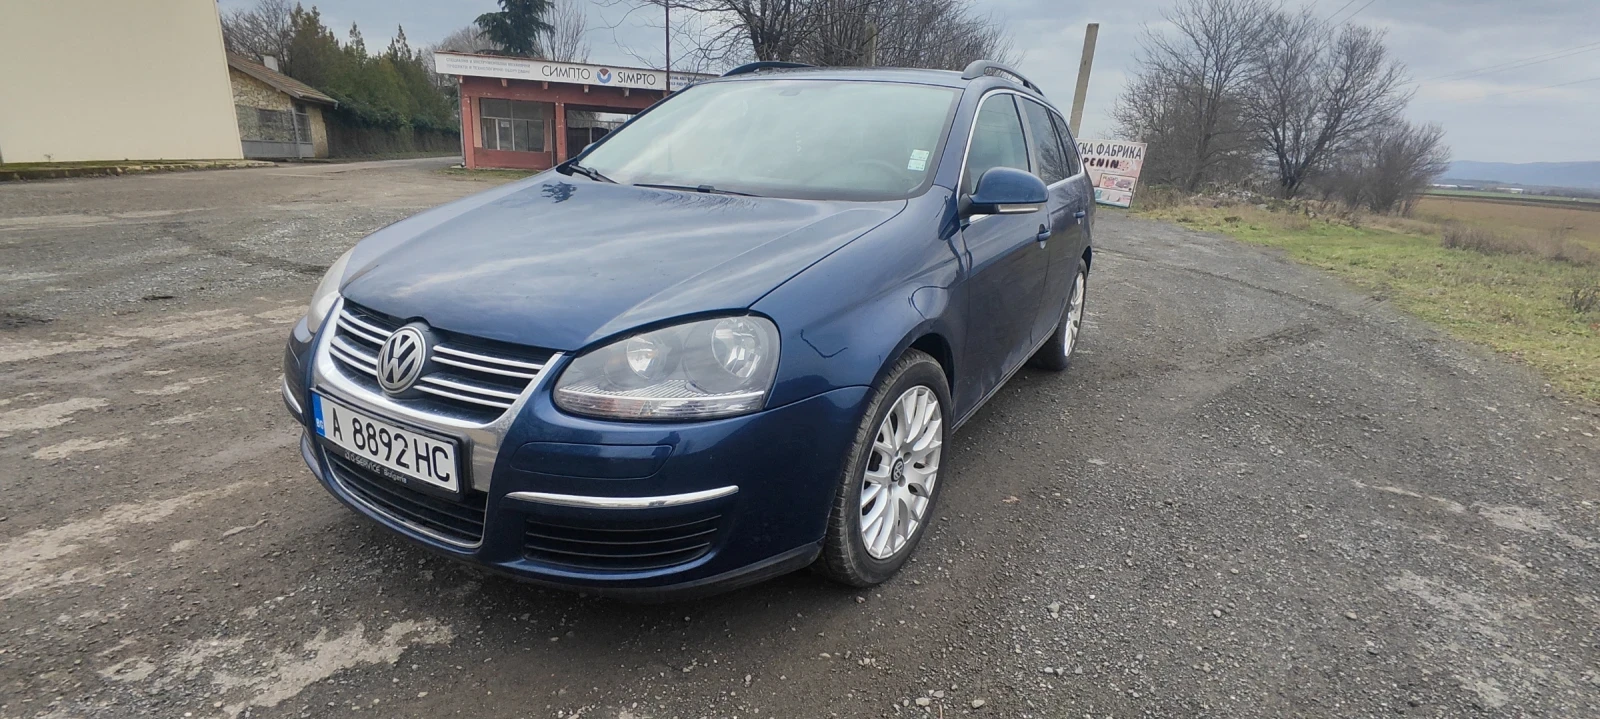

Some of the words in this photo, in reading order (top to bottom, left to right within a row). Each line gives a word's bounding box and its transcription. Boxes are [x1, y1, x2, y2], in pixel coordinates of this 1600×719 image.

[541, 65, 591, 80] СИМПТО
[617, 71, 656, 86] SIMPTO
[1096, 142, 1142, 160] ФАБРИКА
[332, 407, 343, 442] A
[383, 468, 407, 484] Bulgaria
